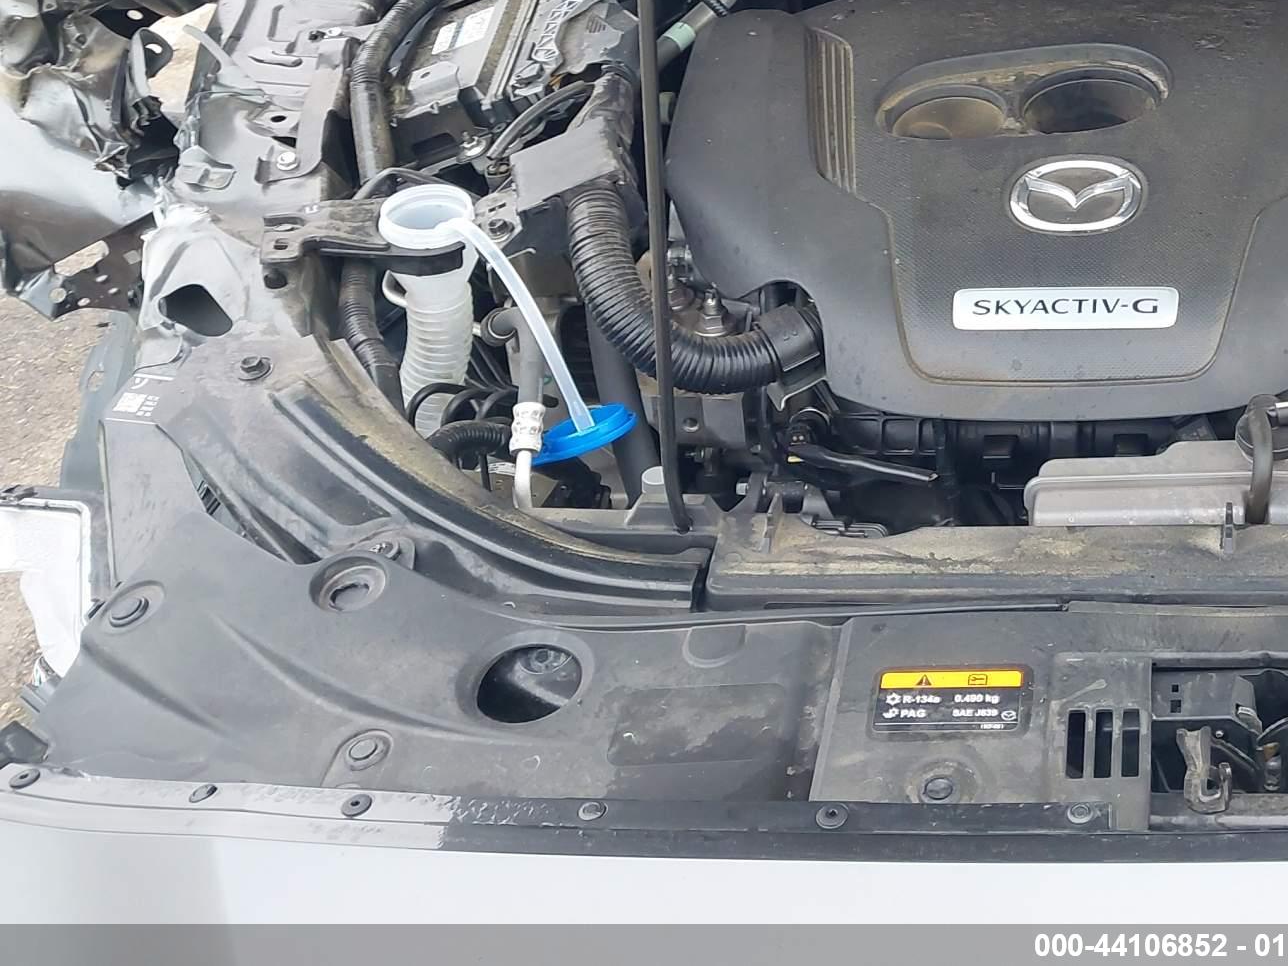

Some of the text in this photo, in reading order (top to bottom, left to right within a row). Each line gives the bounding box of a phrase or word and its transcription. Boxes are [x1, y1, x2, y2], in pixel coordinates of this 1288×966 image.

[973, 298, 1159, 316] SKYACTIV-G
[985, 694, 1000, 704] kg
[900, 709, 927, 718] PAG
[952, 709, 974, 717] SAE
